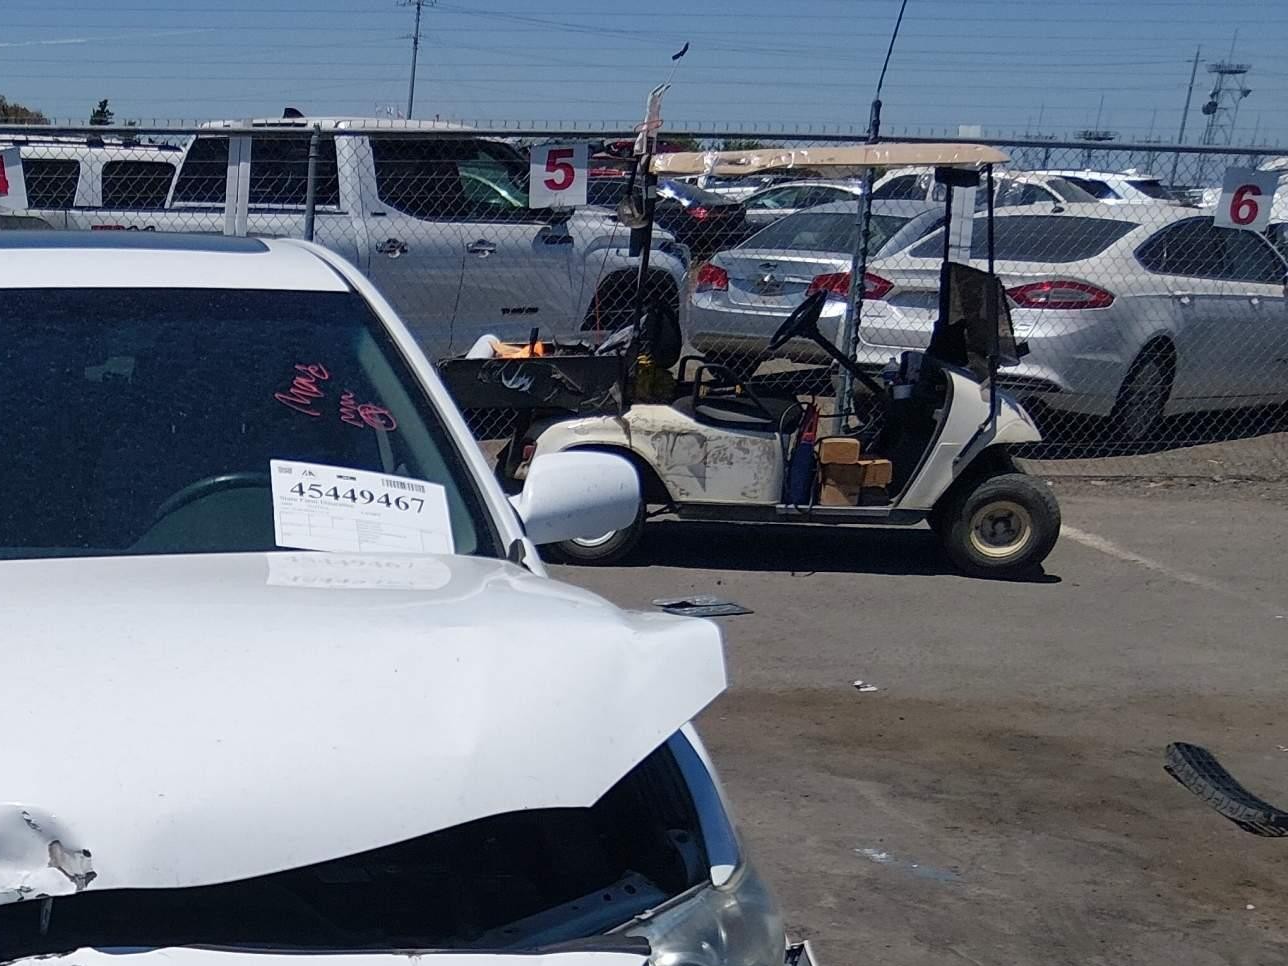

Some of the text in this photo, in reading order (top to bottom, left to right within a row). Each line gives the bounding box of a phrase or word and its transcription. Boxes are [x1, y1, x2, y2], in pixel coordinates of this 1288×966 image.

[543, 147, 576, 192] 5
[1229, 184, 1263, 226] 6
[289, 481, 425, 514] 45449467
